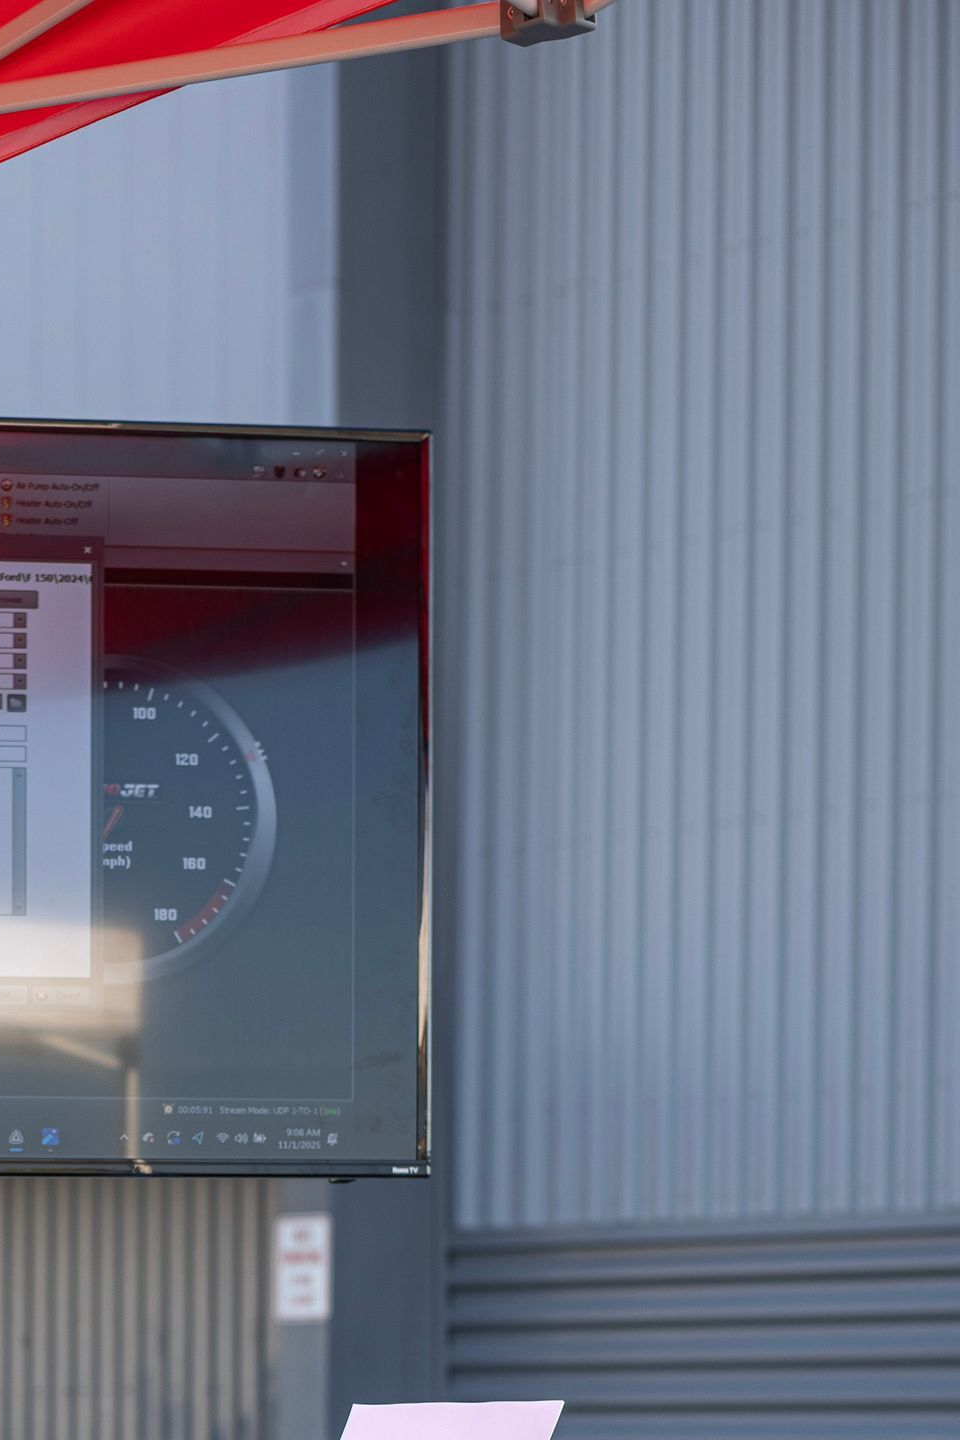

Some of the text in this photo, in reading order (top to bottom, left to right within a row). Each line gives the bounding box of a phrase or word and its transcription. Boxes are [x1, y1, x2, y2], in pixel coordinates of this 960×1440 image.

[132, 707, 157, 720] 100
[175, 753, 199, 766] 120
[188, 806, 212, 819] 140
[182, 857, 206, 870] 160
[154, 908, 178, 921] 180
[220, 1106, 246, 1115] Stream
[247, 1107, 271, 1115] Mode:
[286, 1128, 321, 1138] 9:08 AM
[278, 1141, 321, 1150] 11/1/2025
